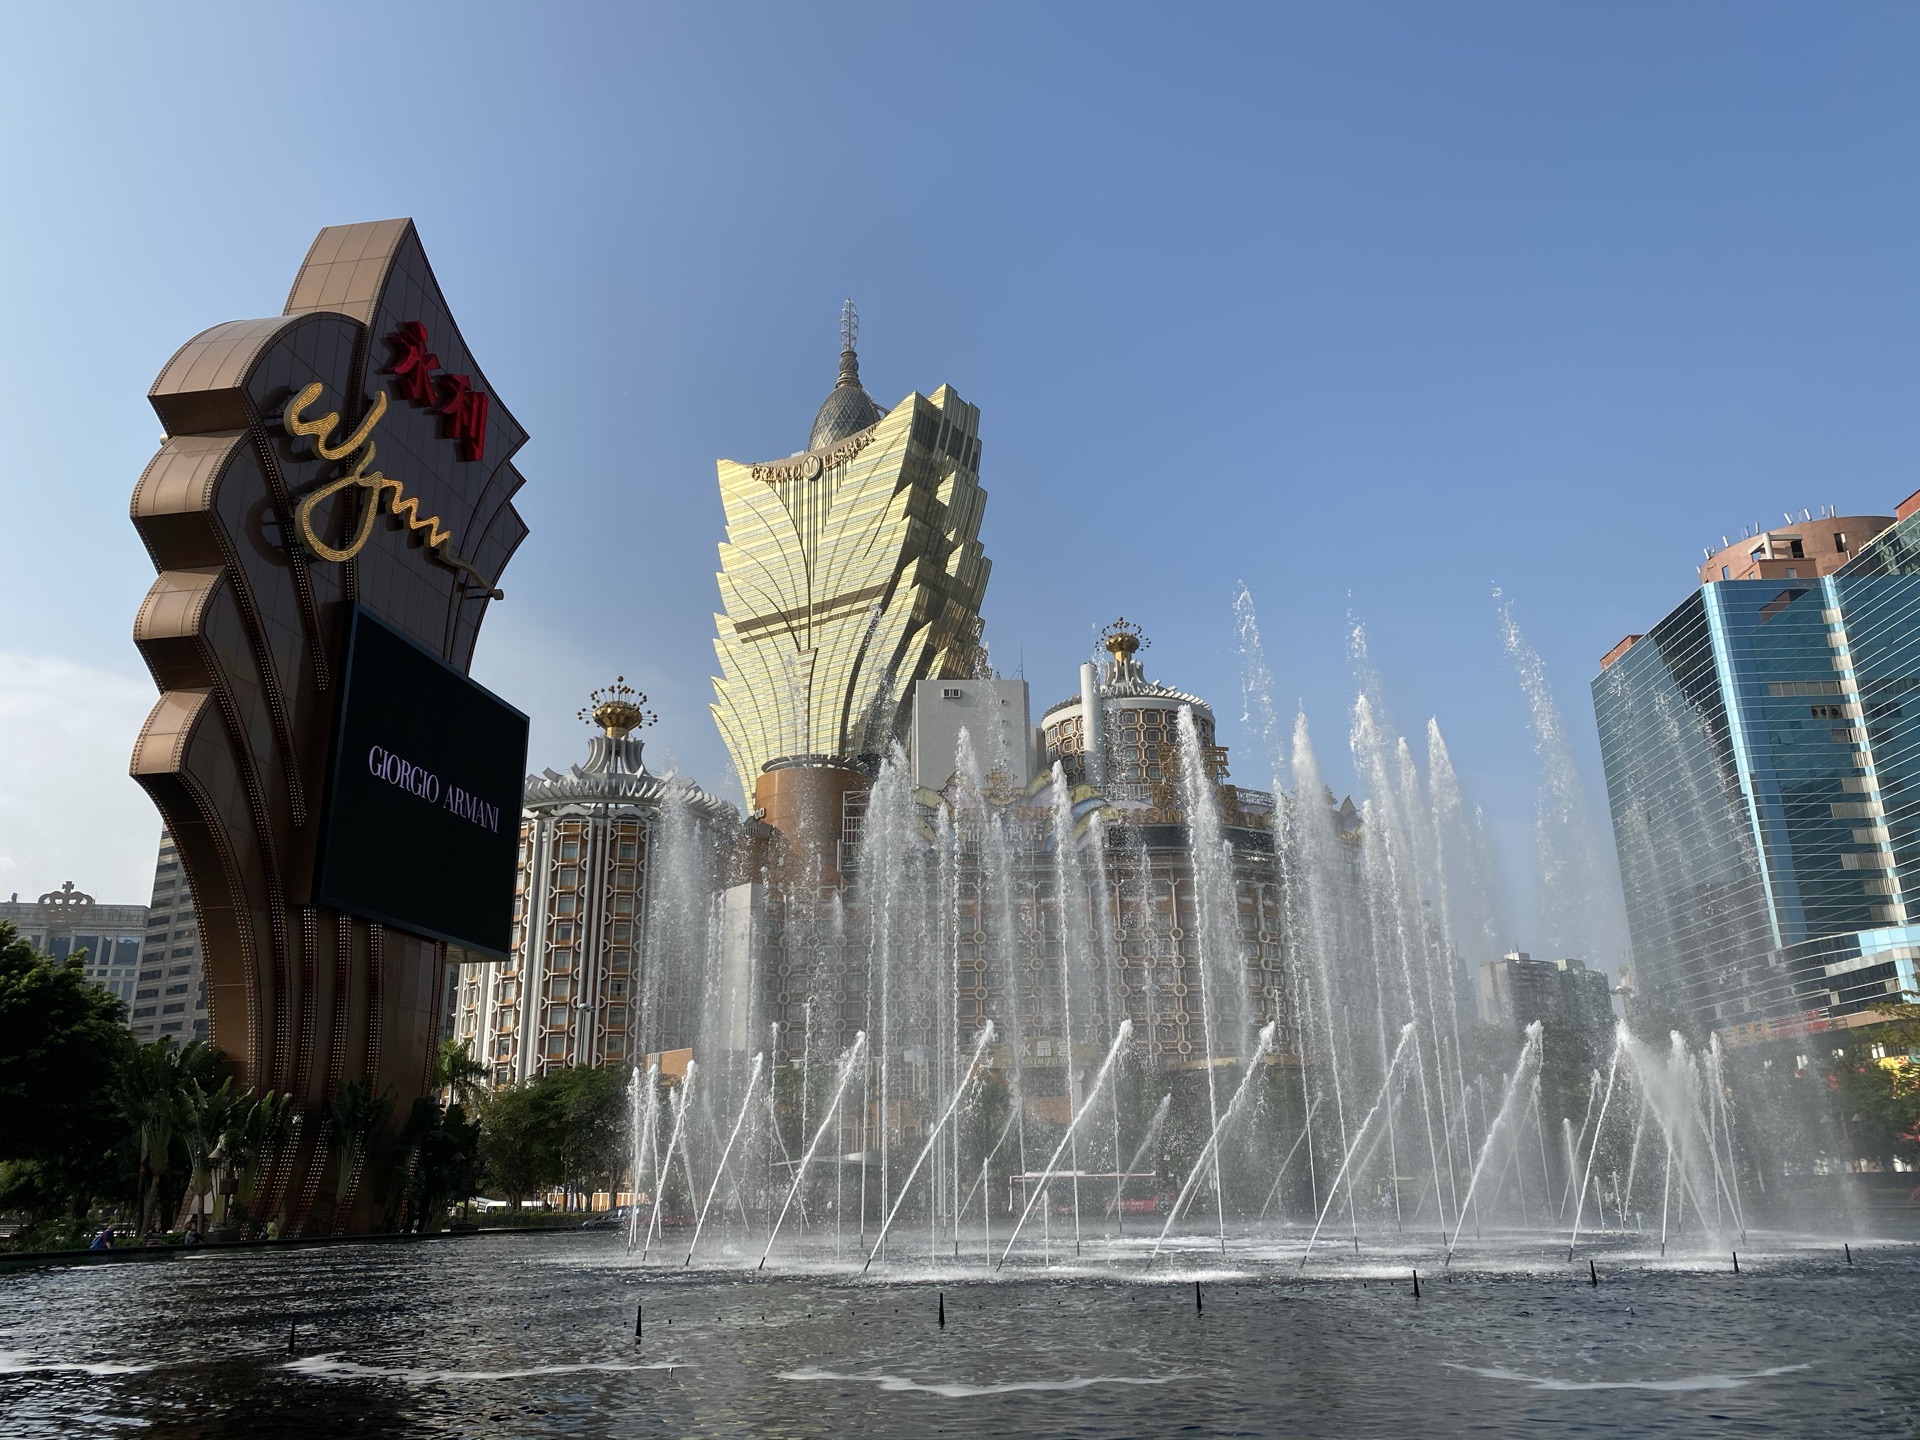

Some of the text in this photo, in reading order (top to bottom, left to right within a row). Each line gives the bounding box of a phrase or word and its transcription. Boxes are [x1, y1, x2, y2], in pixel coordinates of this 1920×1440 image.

[382, 321, 489, 461] 永利
[752, 430, 876, 481] GRAND LISBOA
[368, 745, 499, 833] GIORGIO ARMANI
